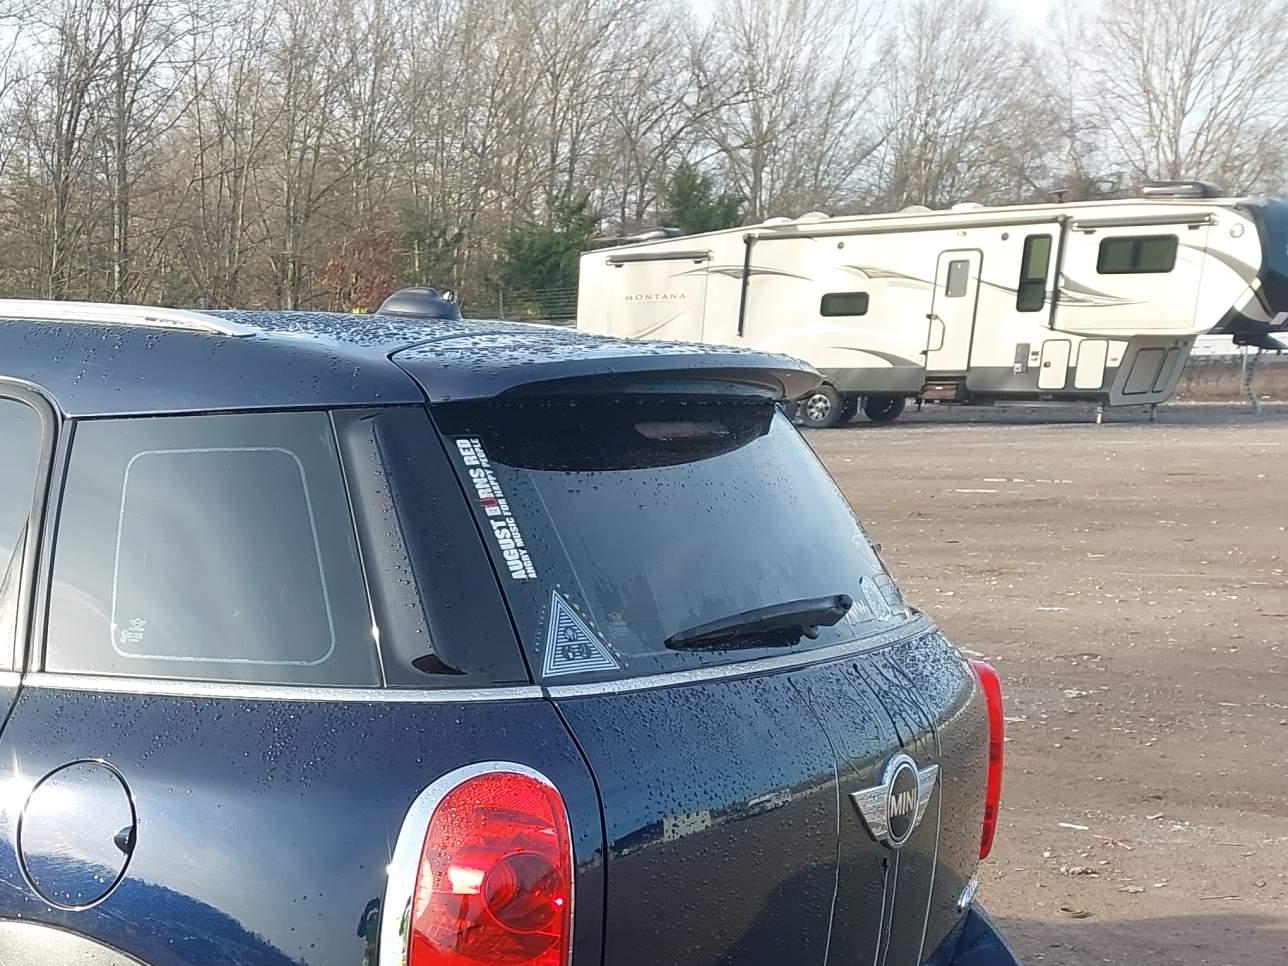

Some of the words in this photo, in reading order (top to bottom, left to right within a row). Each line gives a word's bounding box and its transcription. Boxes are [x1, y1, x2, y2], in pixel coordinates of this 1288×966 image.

[625, 293, 686, 301] MONTANA
[456, 439, 480, 466] RED
[470, 438, 491, 468] PEOPLE
[484, 468, 504, 498] HAPPY
[497, 498, 512, 516] FOR
[506, 516, 525, 548] MUSIC
[489, 519, 528, 579] AUGUST
[518, 548, 538, 579] ANGRY
[891, 788, 918, 818] MINI
